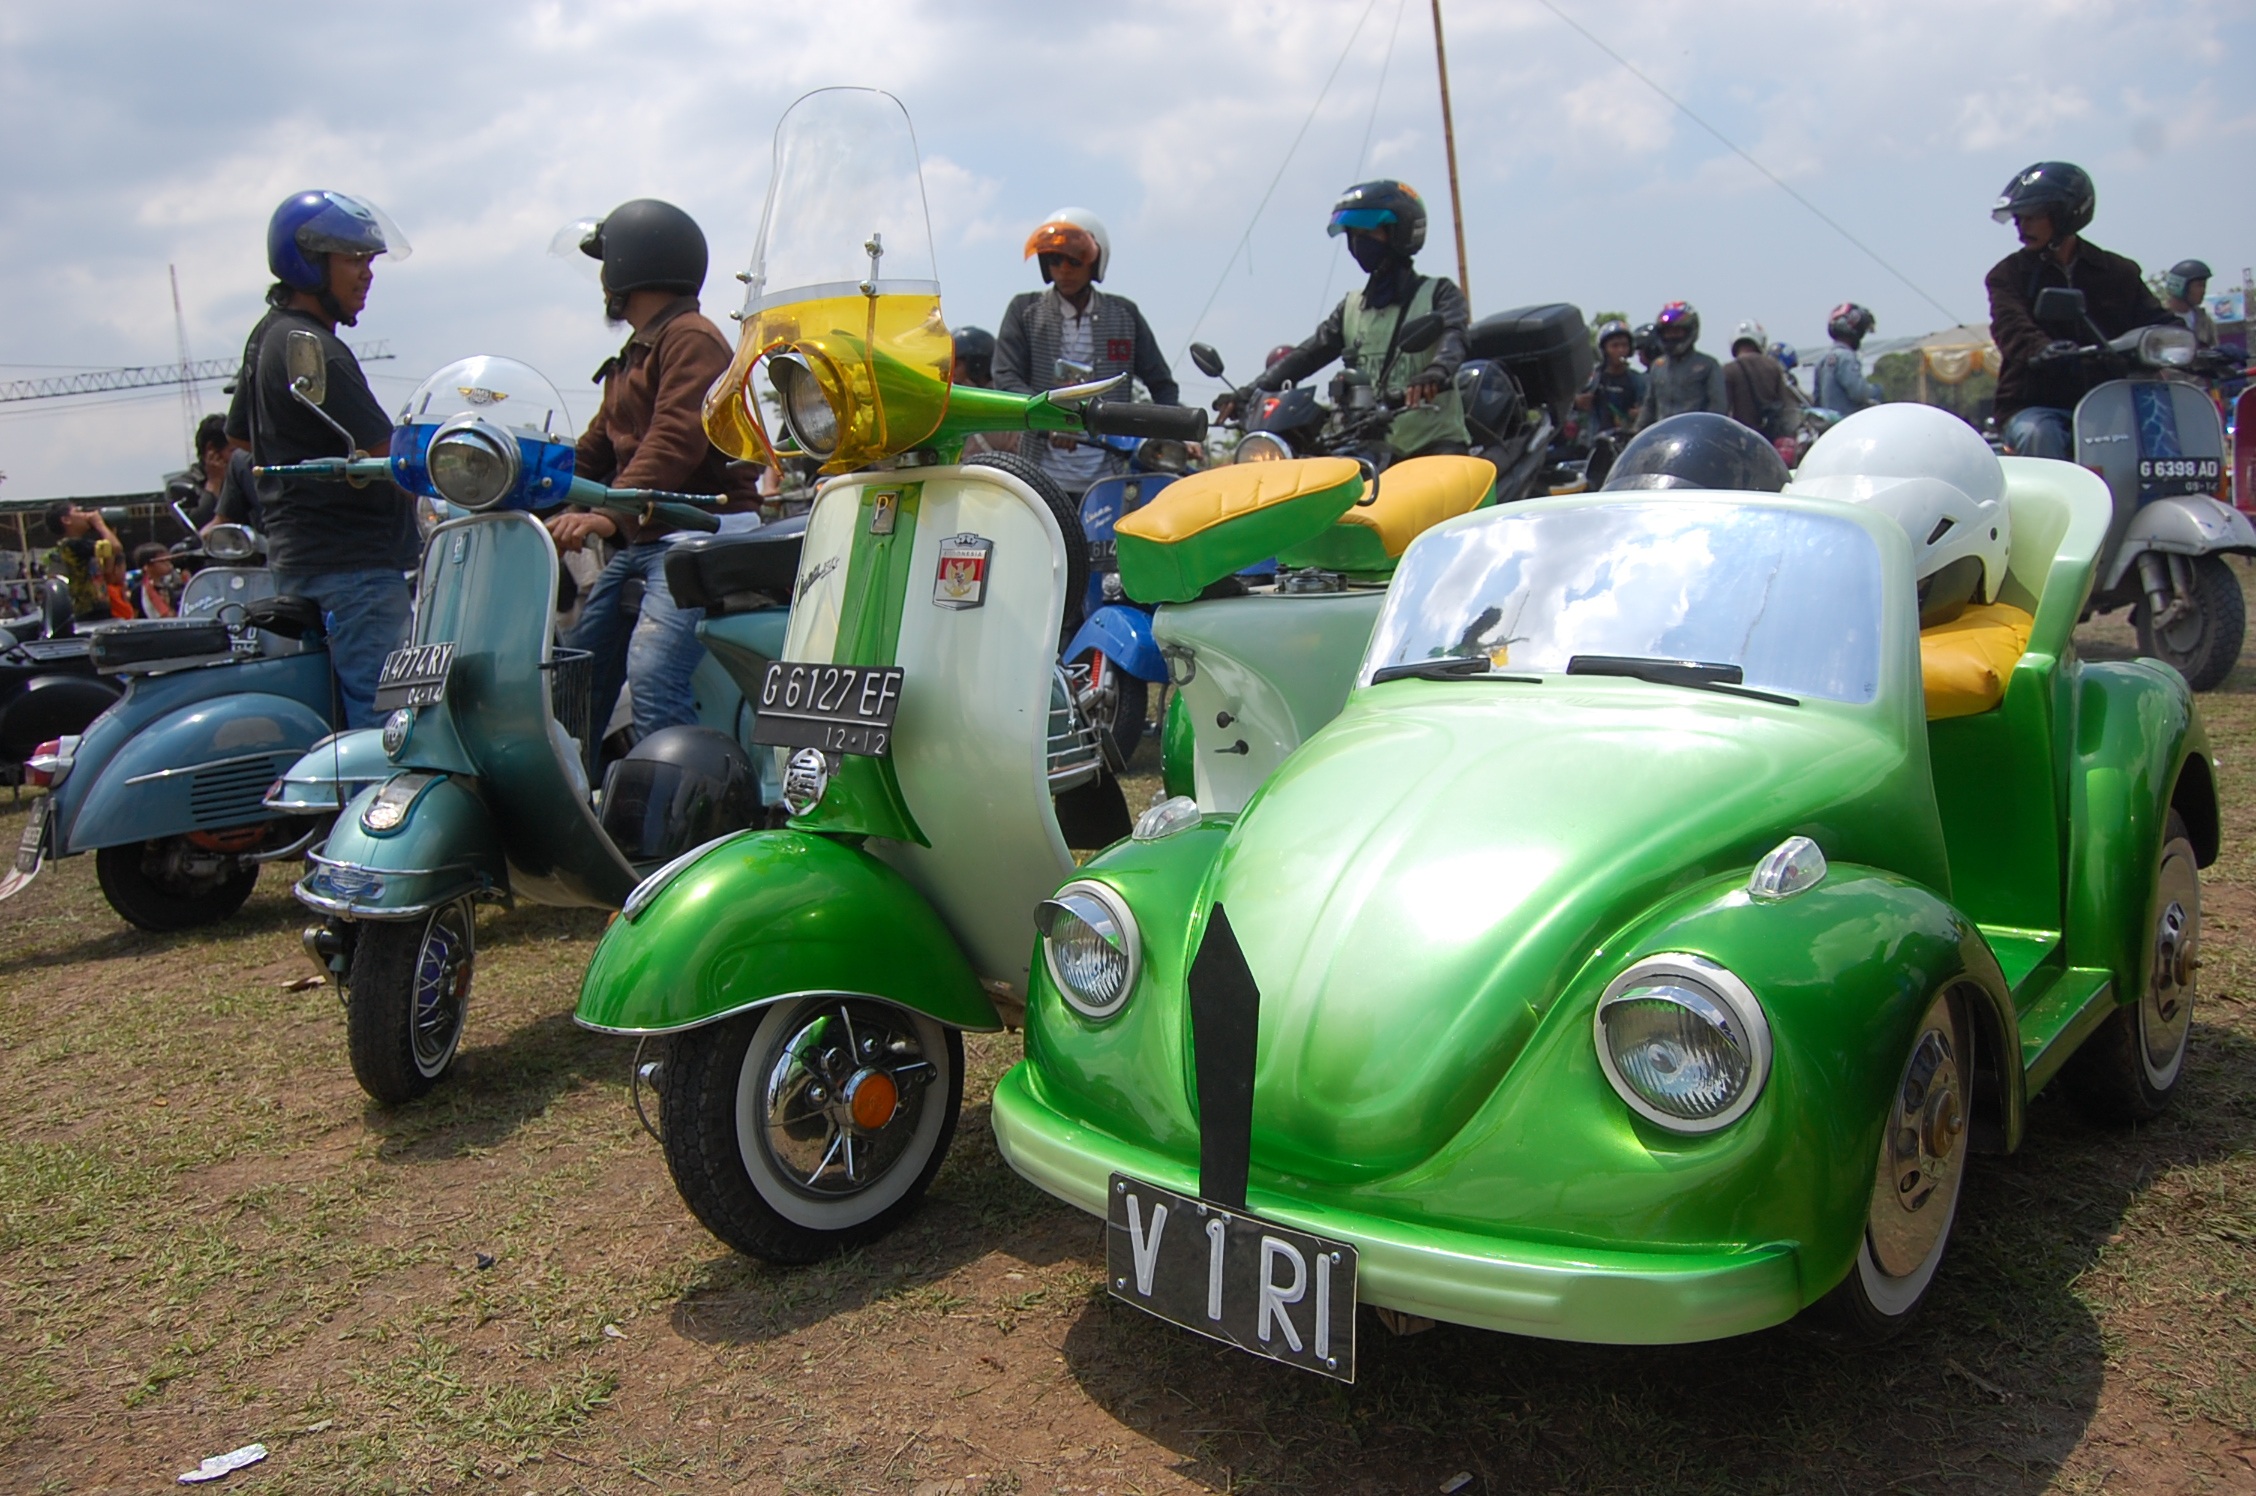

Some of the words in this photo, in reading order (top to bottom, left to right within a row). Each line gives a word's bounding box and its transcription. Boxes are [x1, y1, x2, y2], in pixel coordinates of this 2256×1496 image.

[2140, 461, 2151, 477] G
[2154, 461, 2196, 477] 6398
[2198, 461, 2218, 477] AD
[763, 665, 782, 705] G
[786, 667, 857, 711] 6127
[859, 672, 901, 715] EF
[1126, 1194, 1168, 1297] V
[1206, 1218, 1225, 1321] 1
[1258, 1235, 1330, 1360] RI
